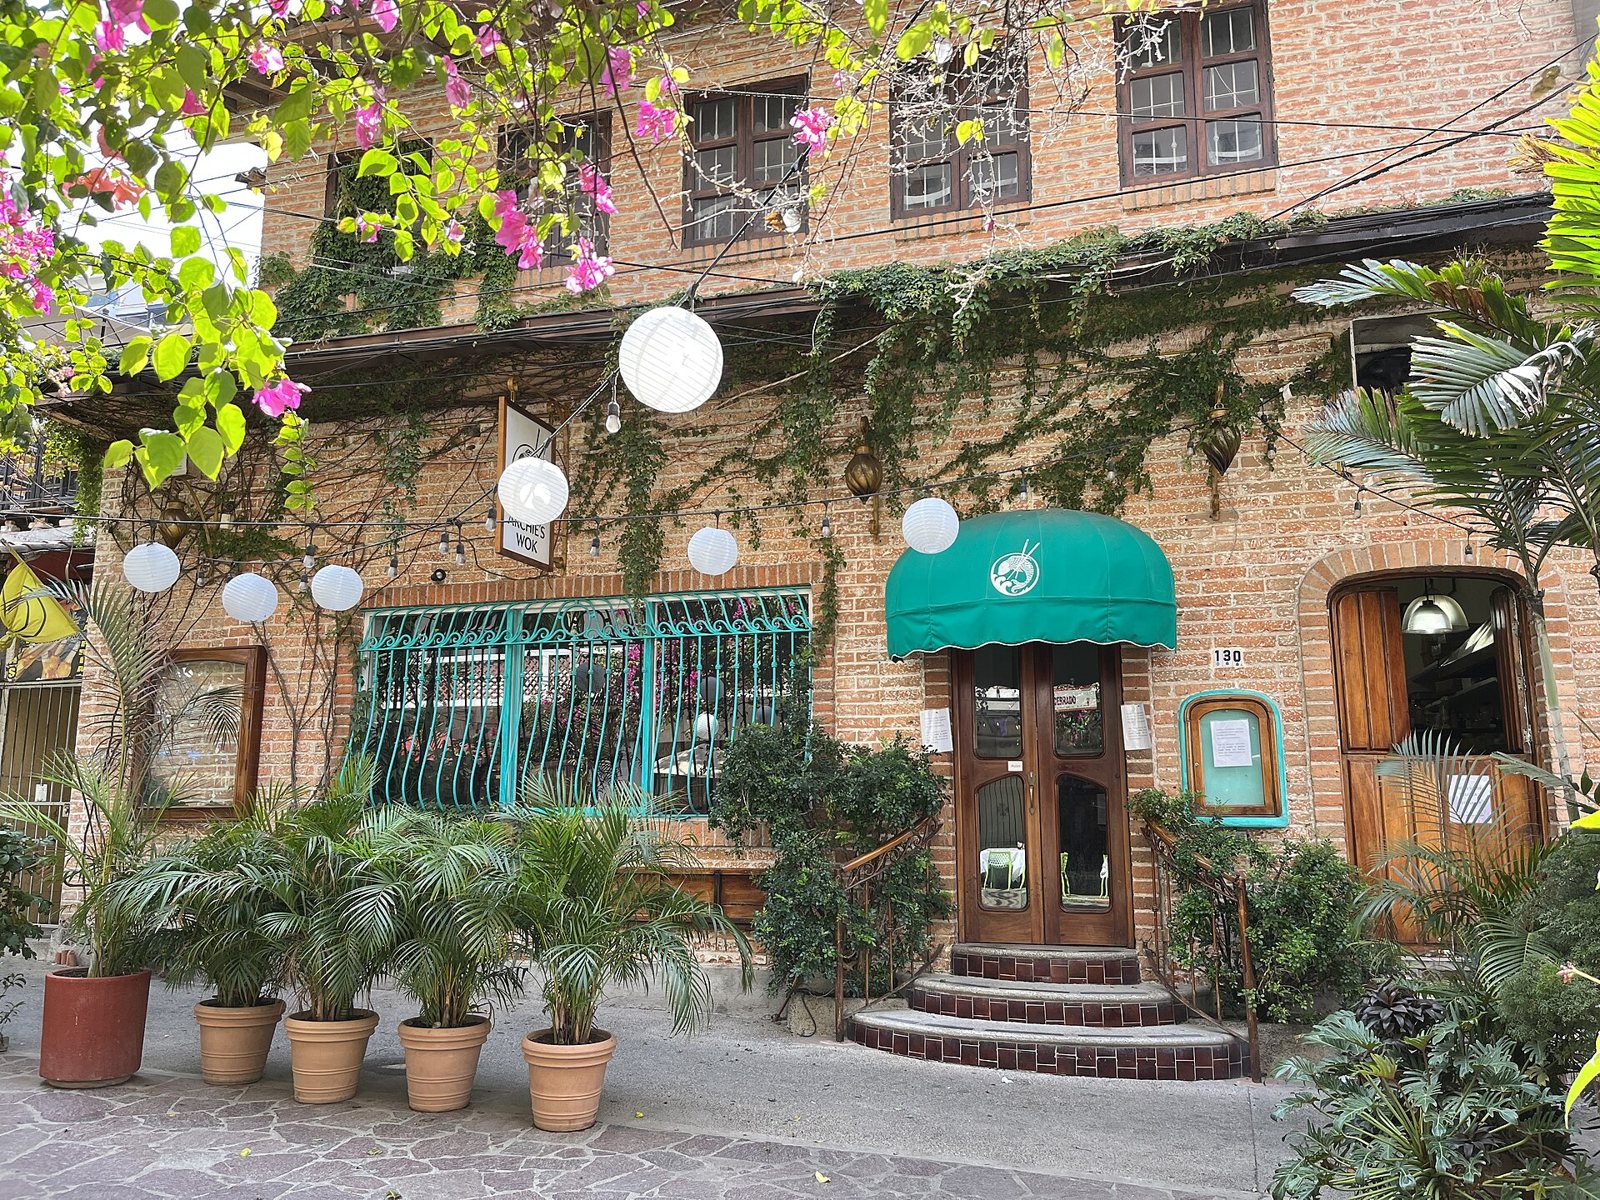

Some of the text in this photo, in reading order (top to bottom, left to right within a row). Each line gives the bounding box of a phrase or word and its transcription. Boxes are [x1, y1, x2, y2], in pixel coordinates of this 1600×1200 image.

[507, 515, 546, 539] ARCHIE'S
[516, 532, 538, 553] WOK
[1214, 649, 1241, 662] 130
